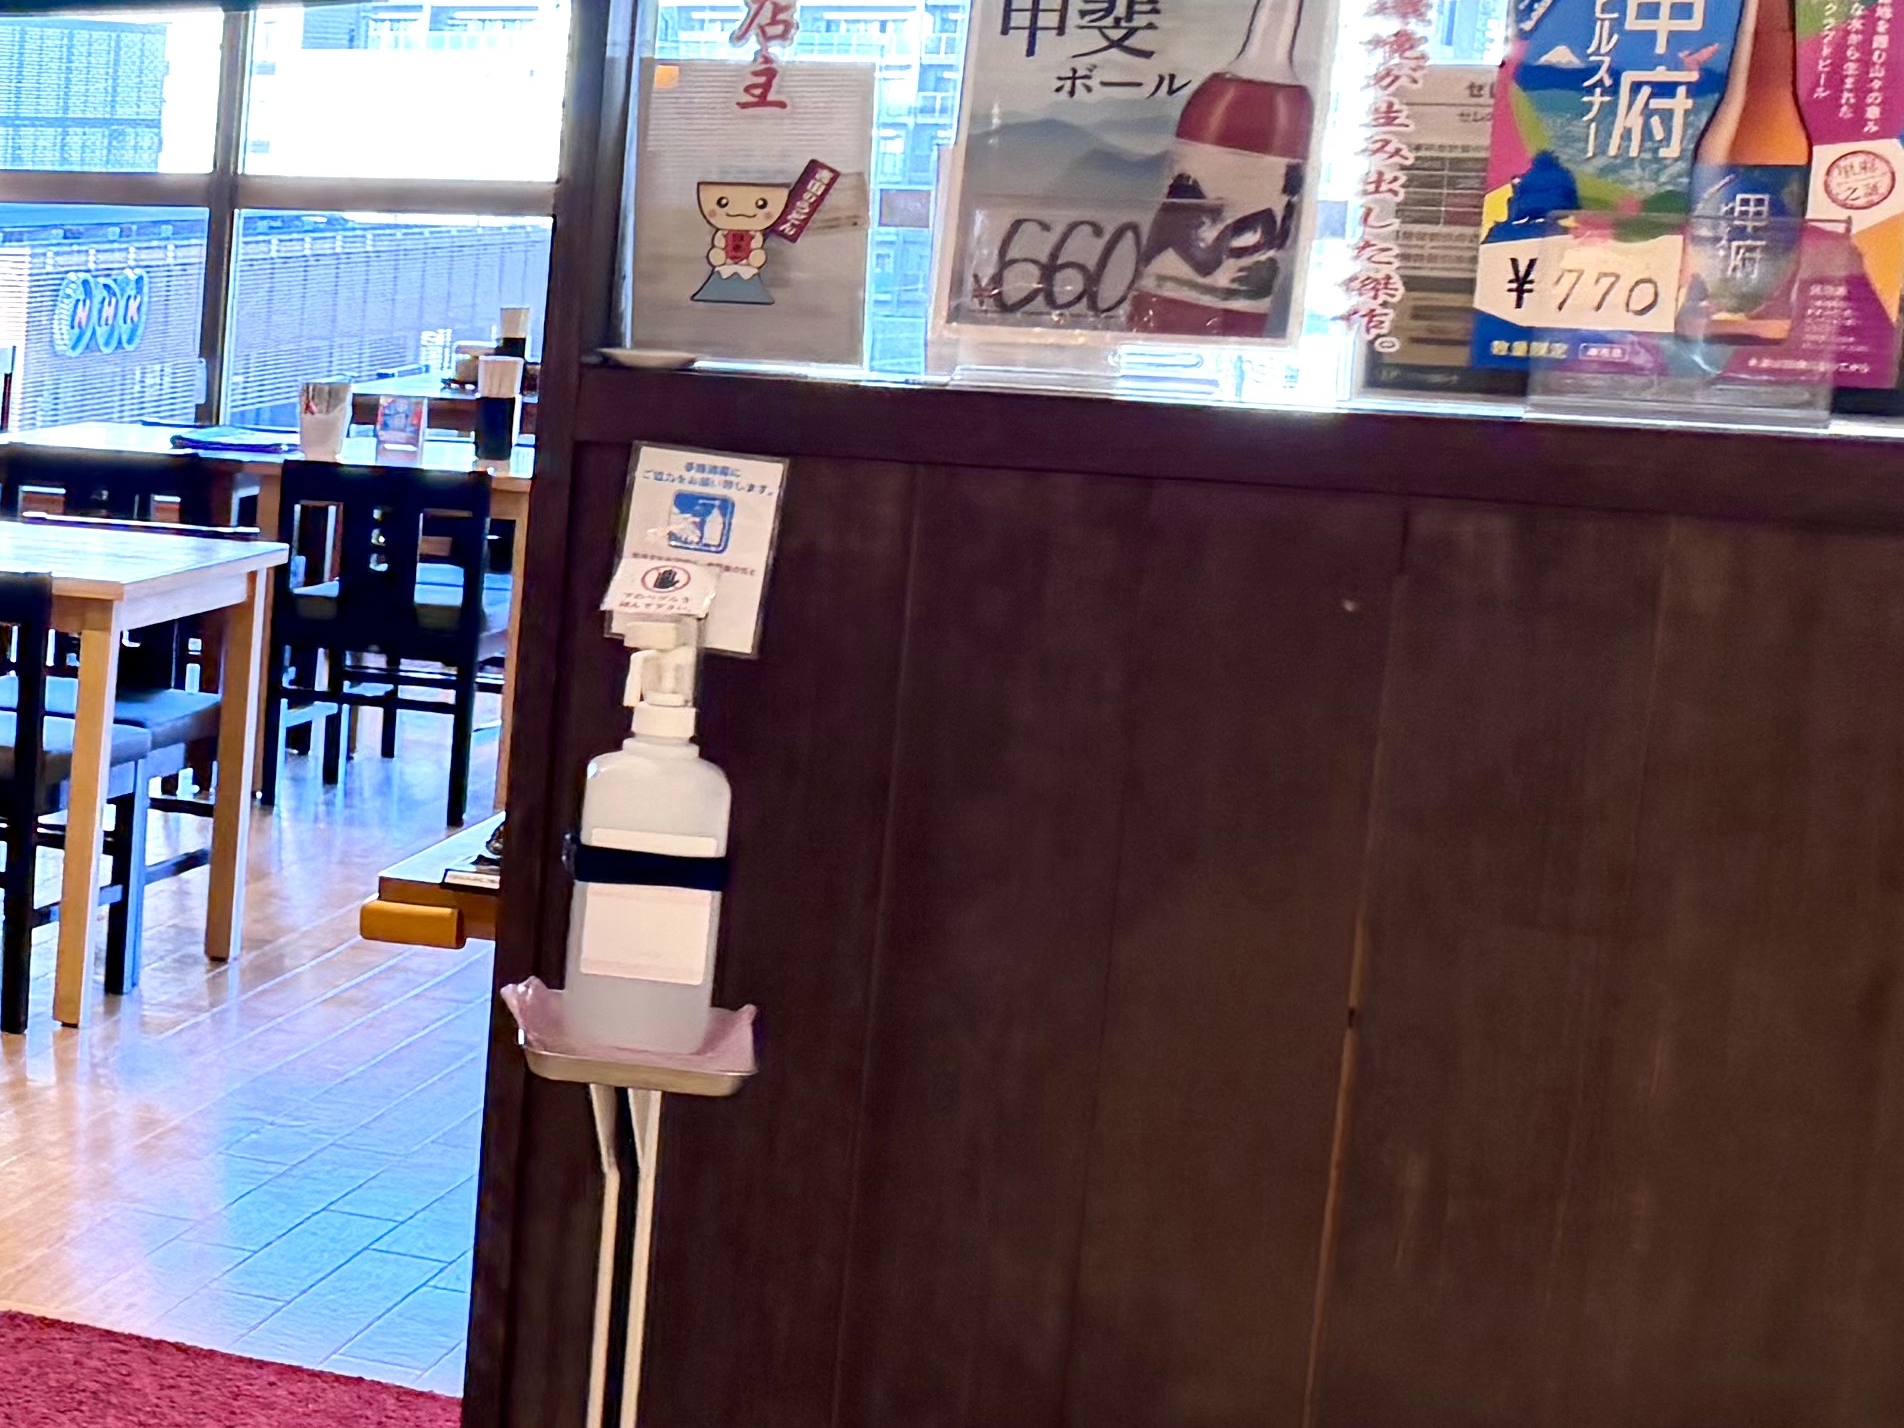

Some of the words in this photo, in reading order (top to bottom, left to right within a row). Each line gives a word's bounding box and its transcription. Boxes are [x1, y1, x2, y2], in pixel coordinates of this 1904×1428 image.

[1054, 66, 1192, 99] ボール
[1727, 193, 1770, 278] 甲府
[1506, 257, 1660, 317] ¥770
